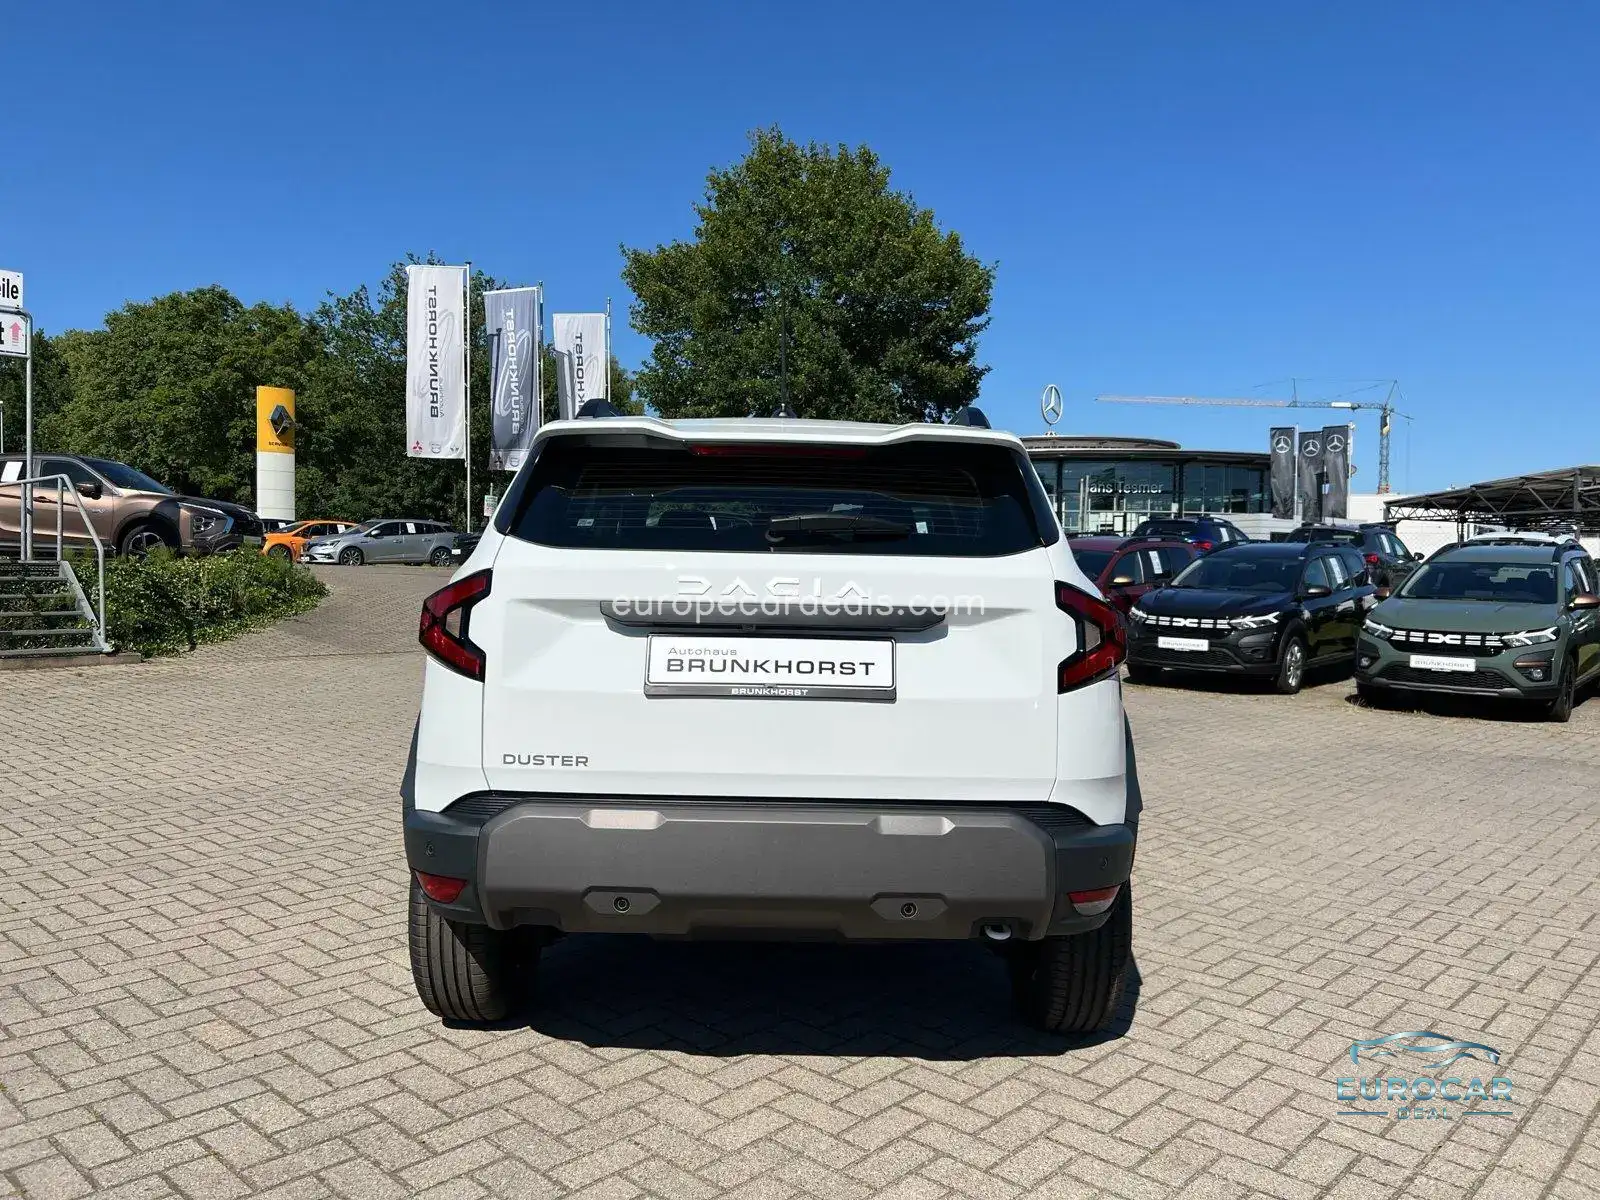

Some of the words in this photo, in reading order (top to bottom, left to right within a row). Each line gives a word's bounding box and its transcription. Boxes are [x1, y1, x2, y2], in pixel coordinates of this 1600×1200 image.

[0, 277, 19, 299] ile
[676, 575, 869, 599] DACIA
[667, 647, 738, 656] Autohaus
[666, 658, 876, 676] BRUNKHORST
[731, 687, 809, 696] BRUNKHORST
[502, 753, 589, 767] DUSTER
